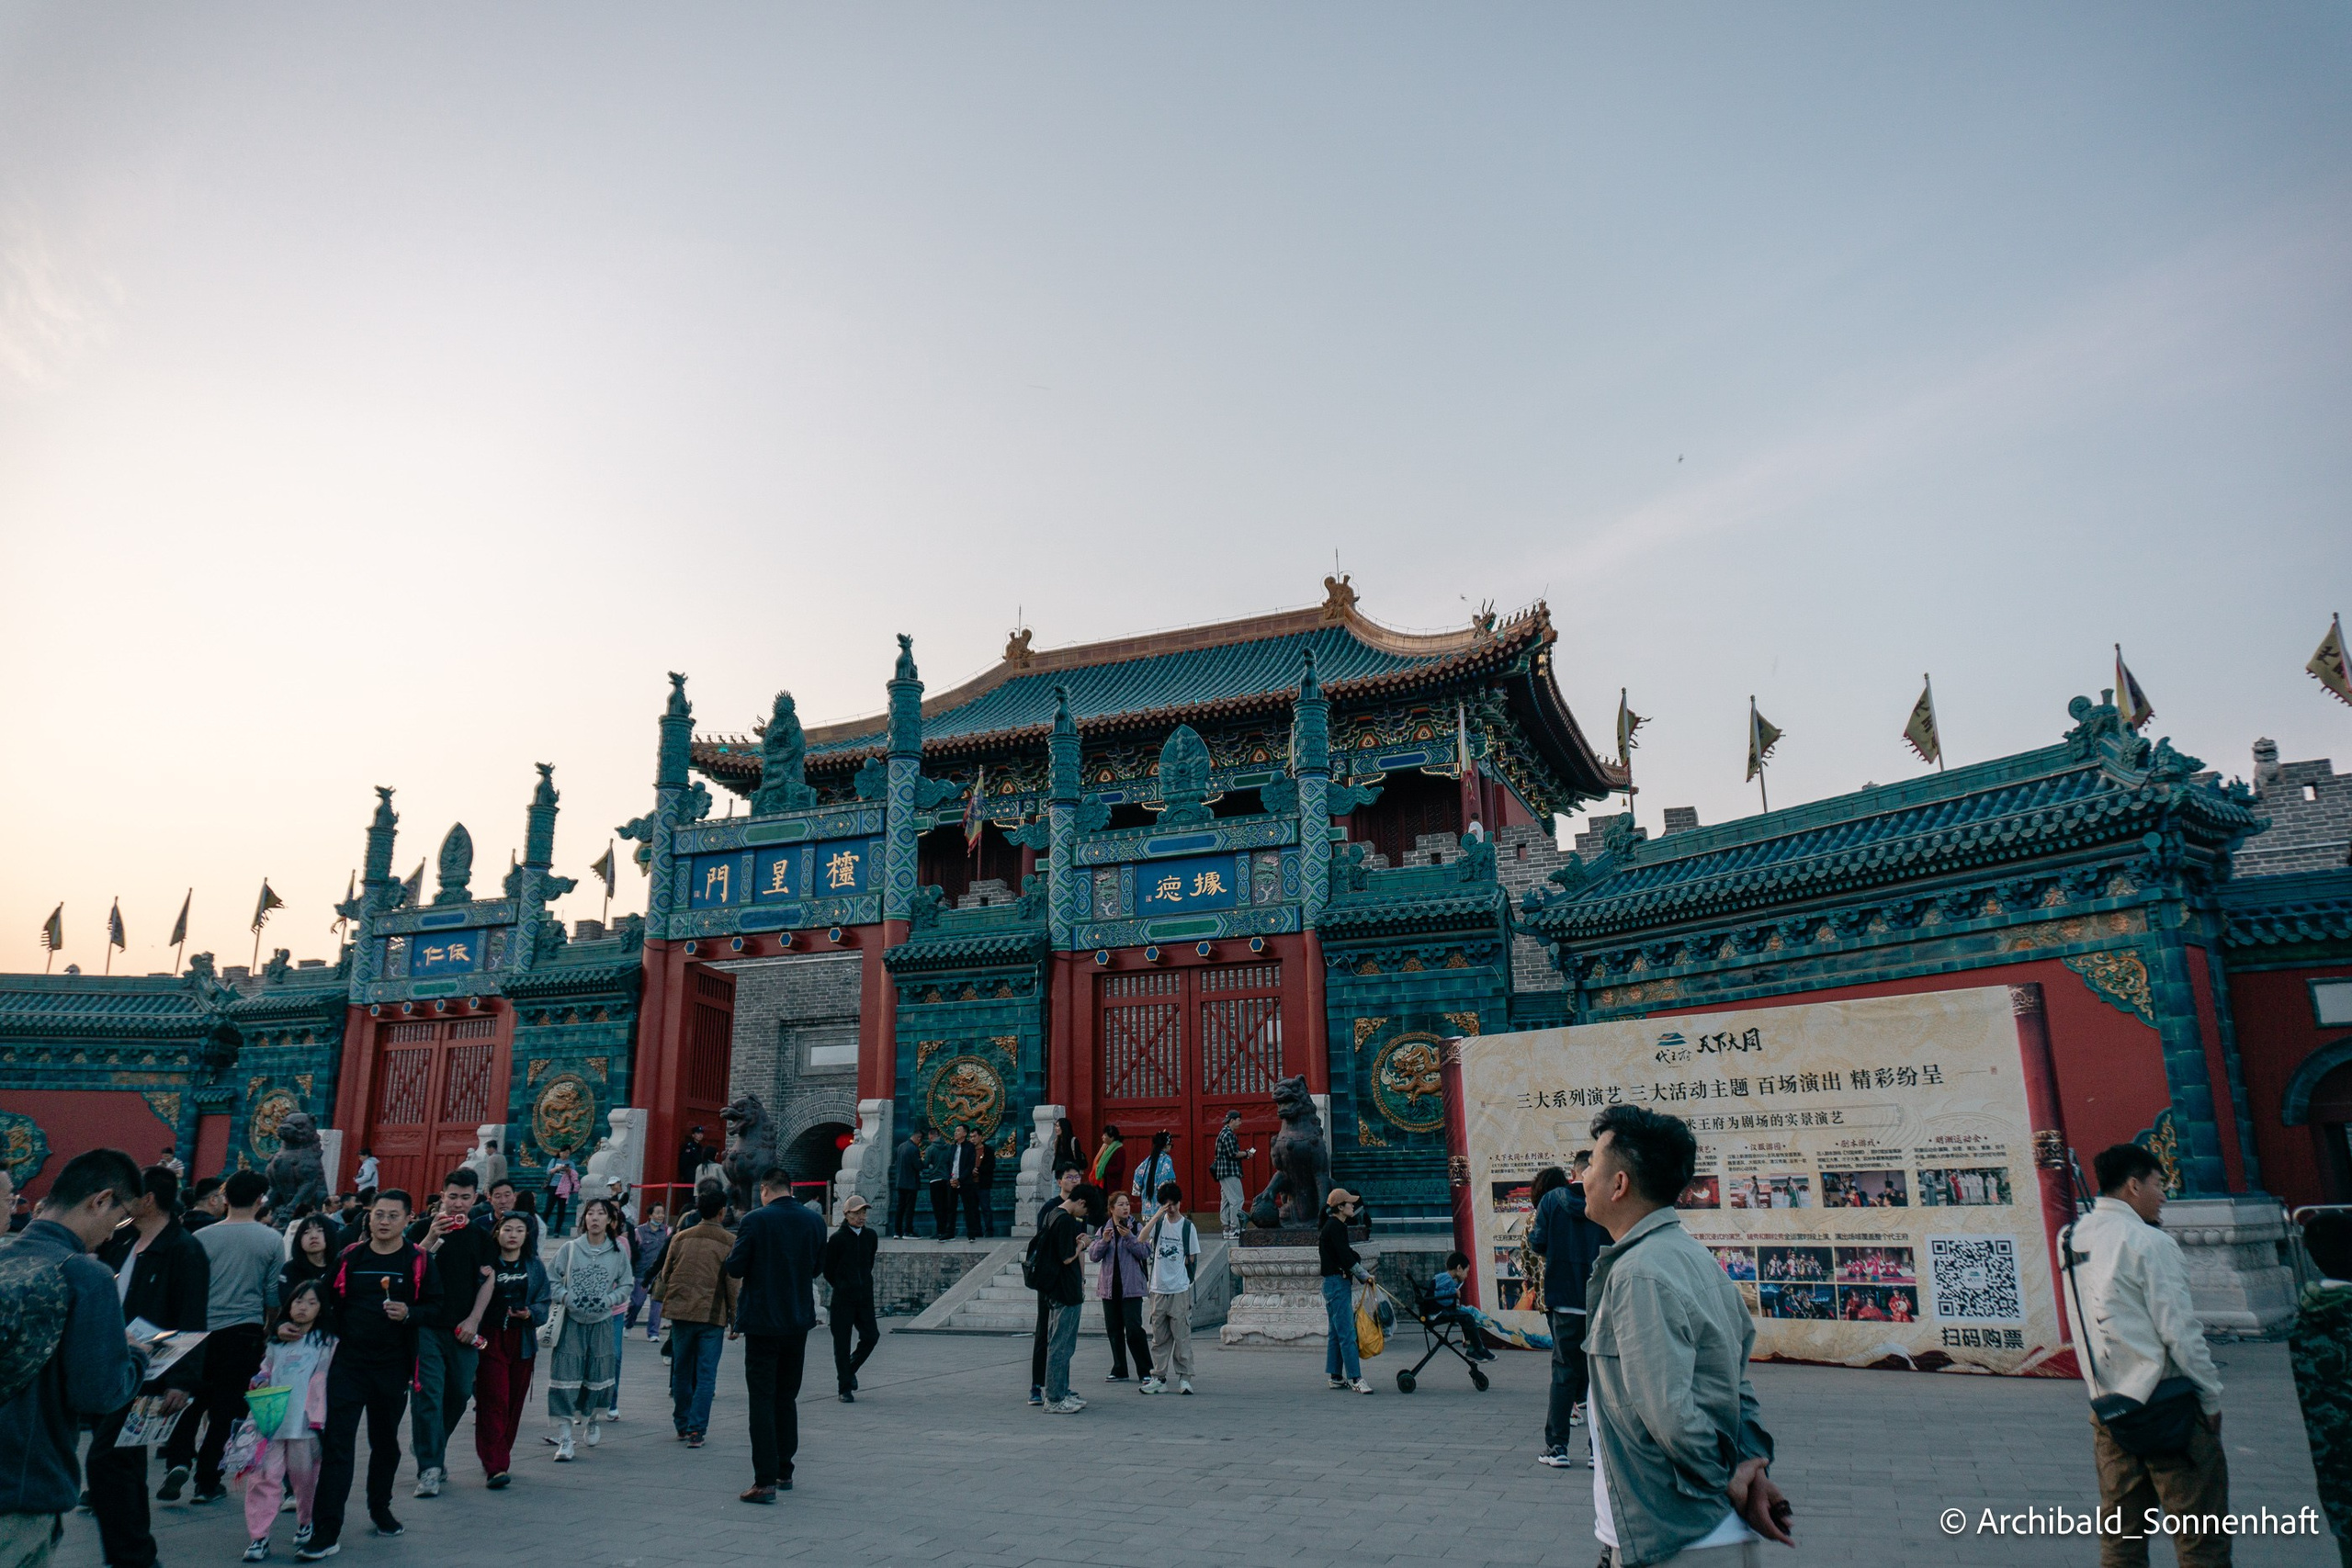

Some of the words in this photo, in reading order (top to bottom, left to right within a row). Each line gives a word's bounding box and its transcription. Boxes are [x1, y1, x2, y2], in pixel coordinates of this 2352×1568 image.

[1696, 1027, 1762, 1055] 天下大同
[1516, 1086, 1623, 1110] 三大系列演艺
[1629, 1077, 1749, 1101] 三大活动主题
[1756, 1070, 1842, 1096] 百场演出
[1849, 1064, 1945, 1089] 精彩纷呈
[1940, 1326, 2025, 1349] 扫码购票
